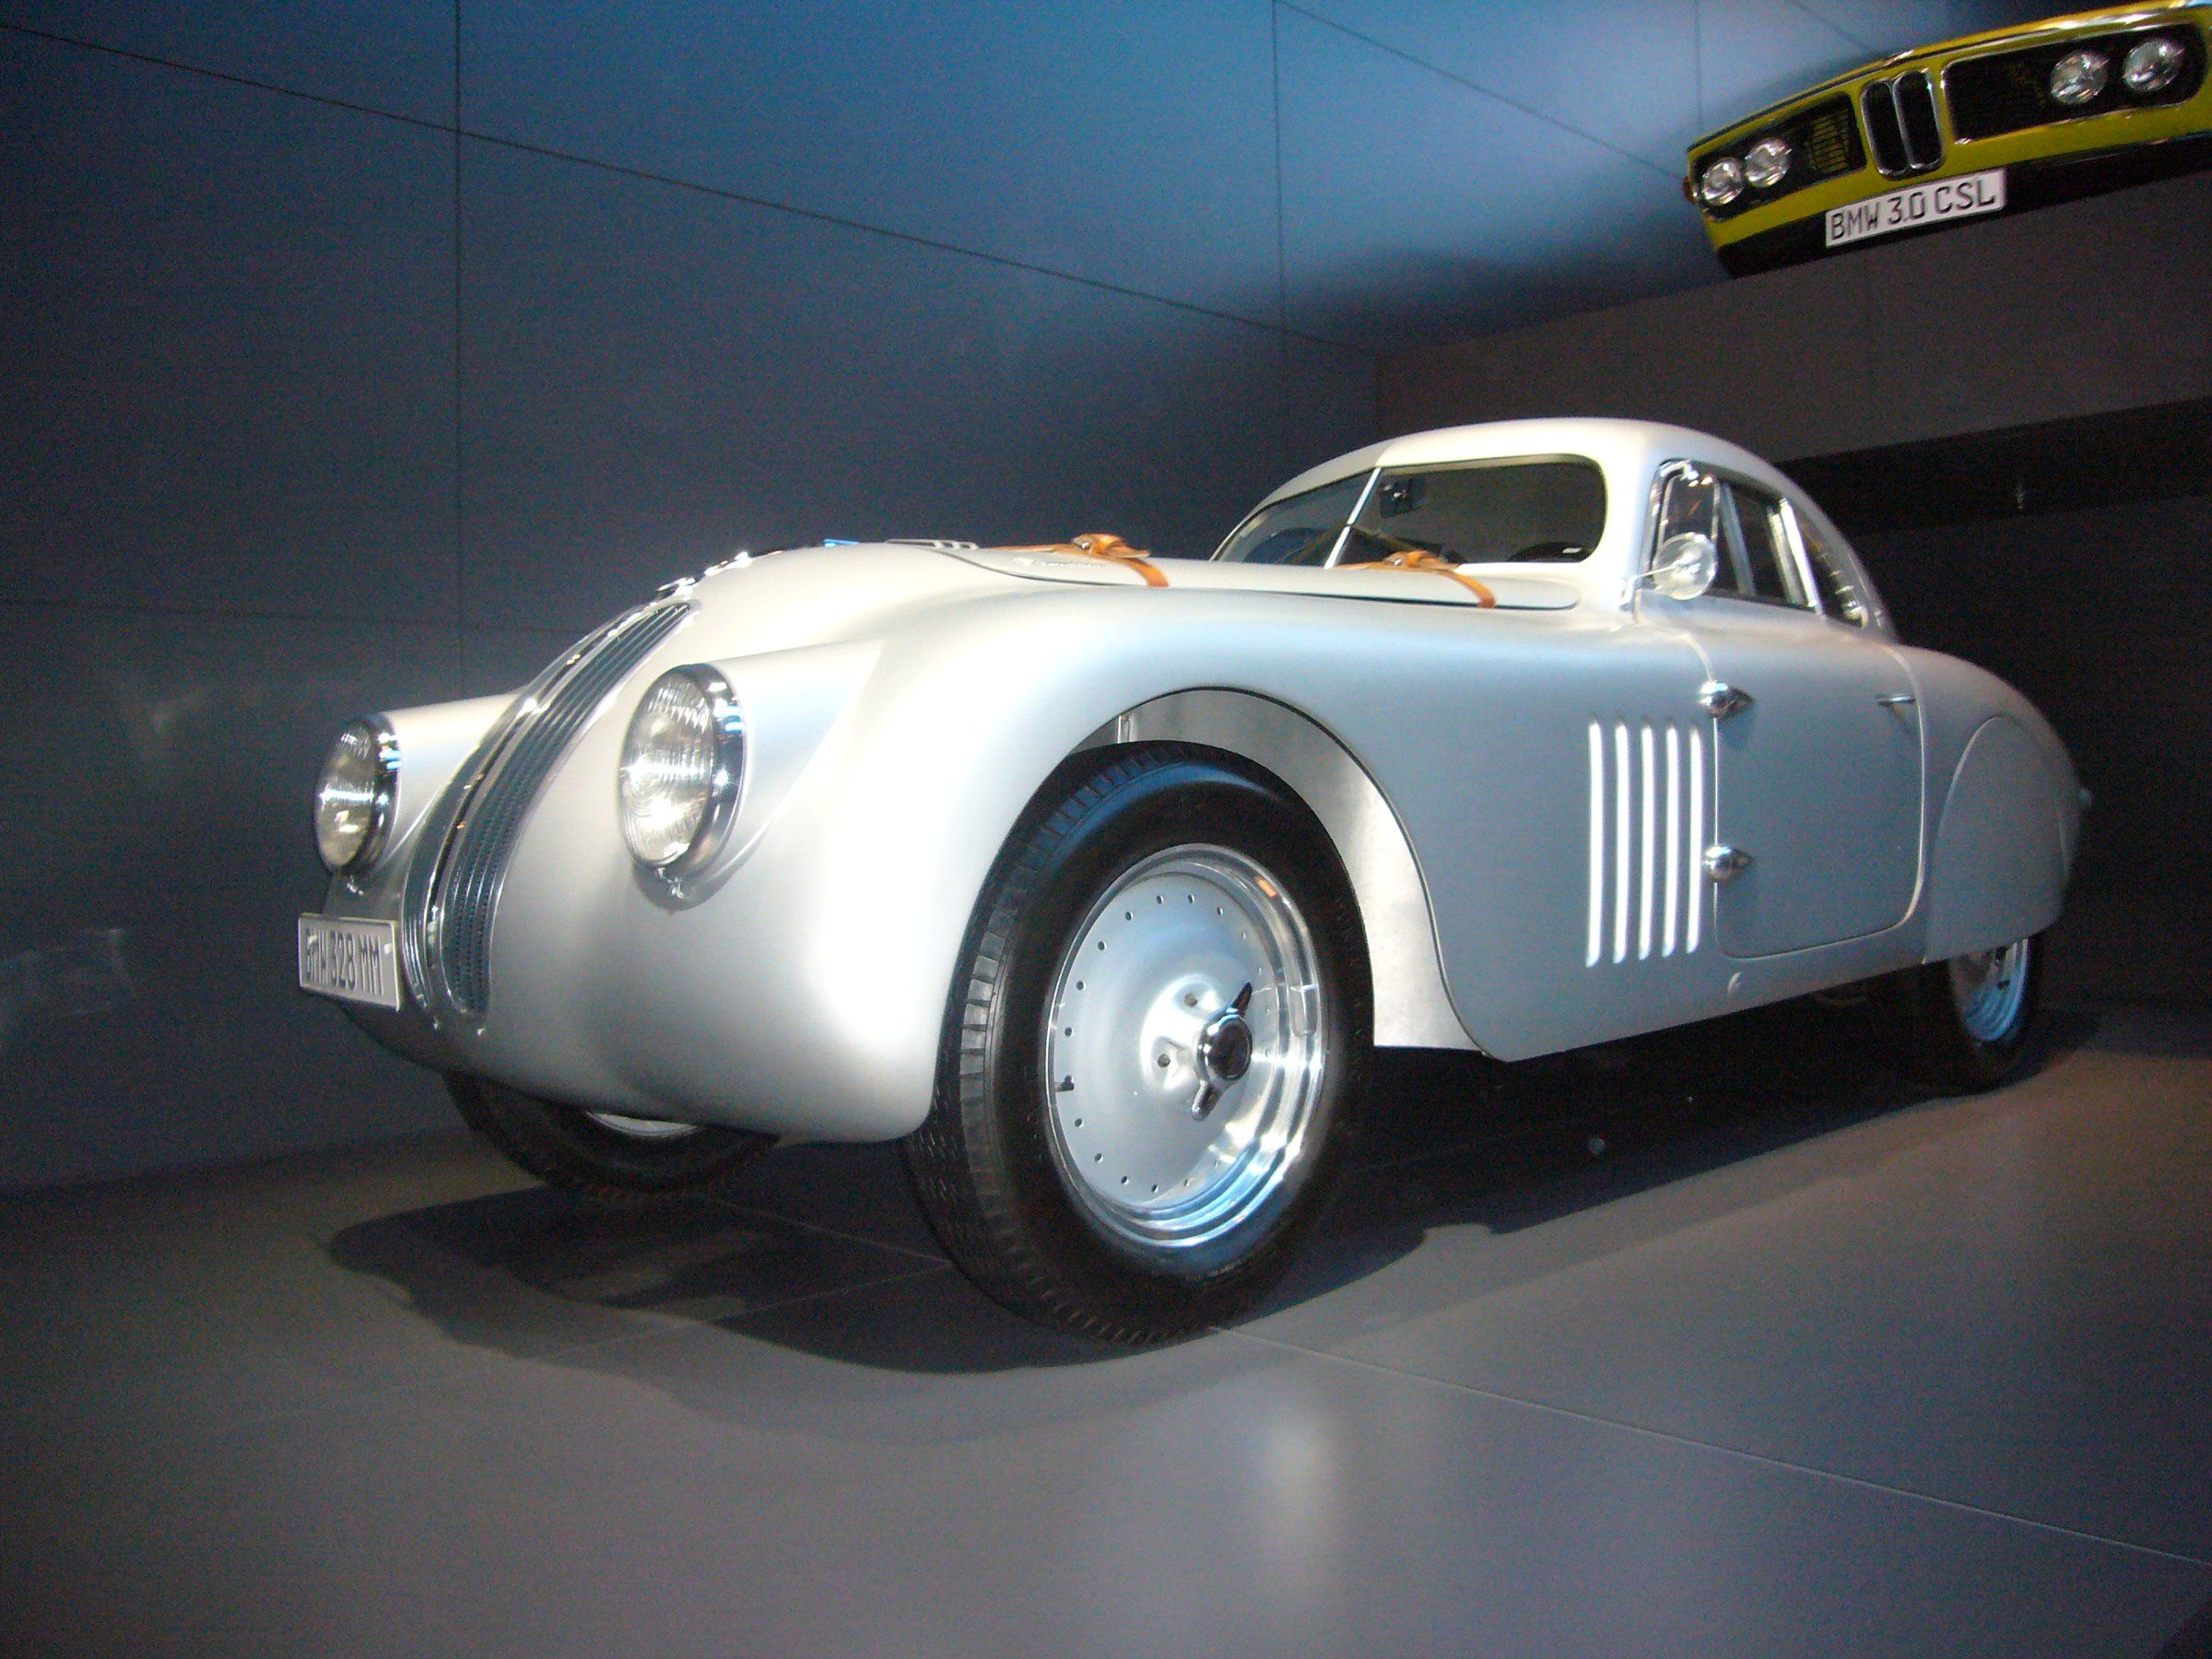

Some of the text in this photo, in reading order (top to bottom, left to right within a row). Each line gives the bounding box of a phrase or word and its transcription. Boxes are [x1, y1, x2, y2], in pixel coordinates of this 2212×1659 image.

[1830, 180, 1995, 240] BMW 3.0 CSL
[330, 930, 357, 991] 328
[359, 934, 384, 996] MM
